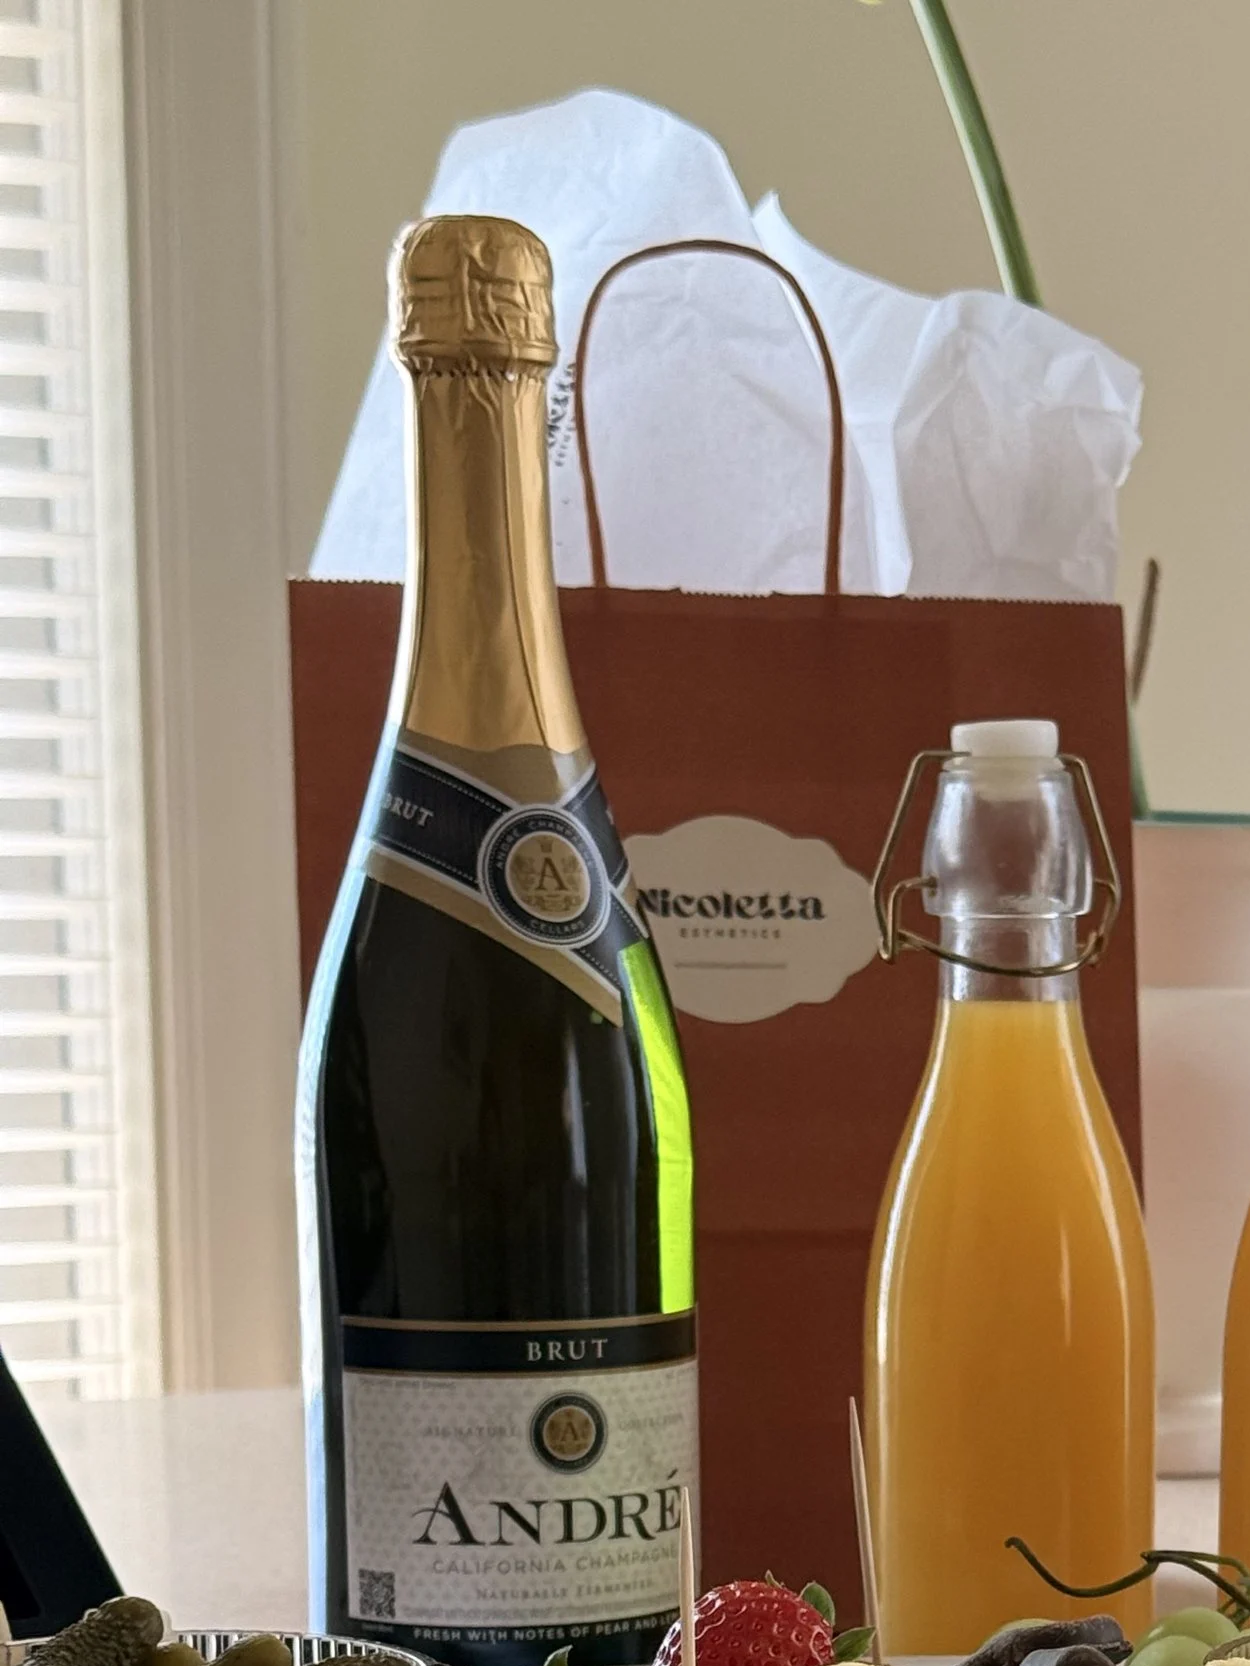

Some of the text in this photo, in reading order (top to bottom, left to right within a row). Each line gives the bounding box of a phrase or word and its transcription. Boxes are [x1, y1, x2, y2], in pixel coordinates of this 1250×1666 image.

[535, 856, 569, 891] A
[636, 888, 826, 921] Nicoletta
[527, 1338, 608, 1361] BRUT
[412, 1469, 683, 1547] ANDRÉ
[432, 1558, 567, 1576] CALIFORNIA
[413, 1628, 461, 1642] FRESH
[467, 1630, 508, 1642] WITH
[514, 1627, 566, 1641] NOTES
[571, 1627, 592, 1638] OF
